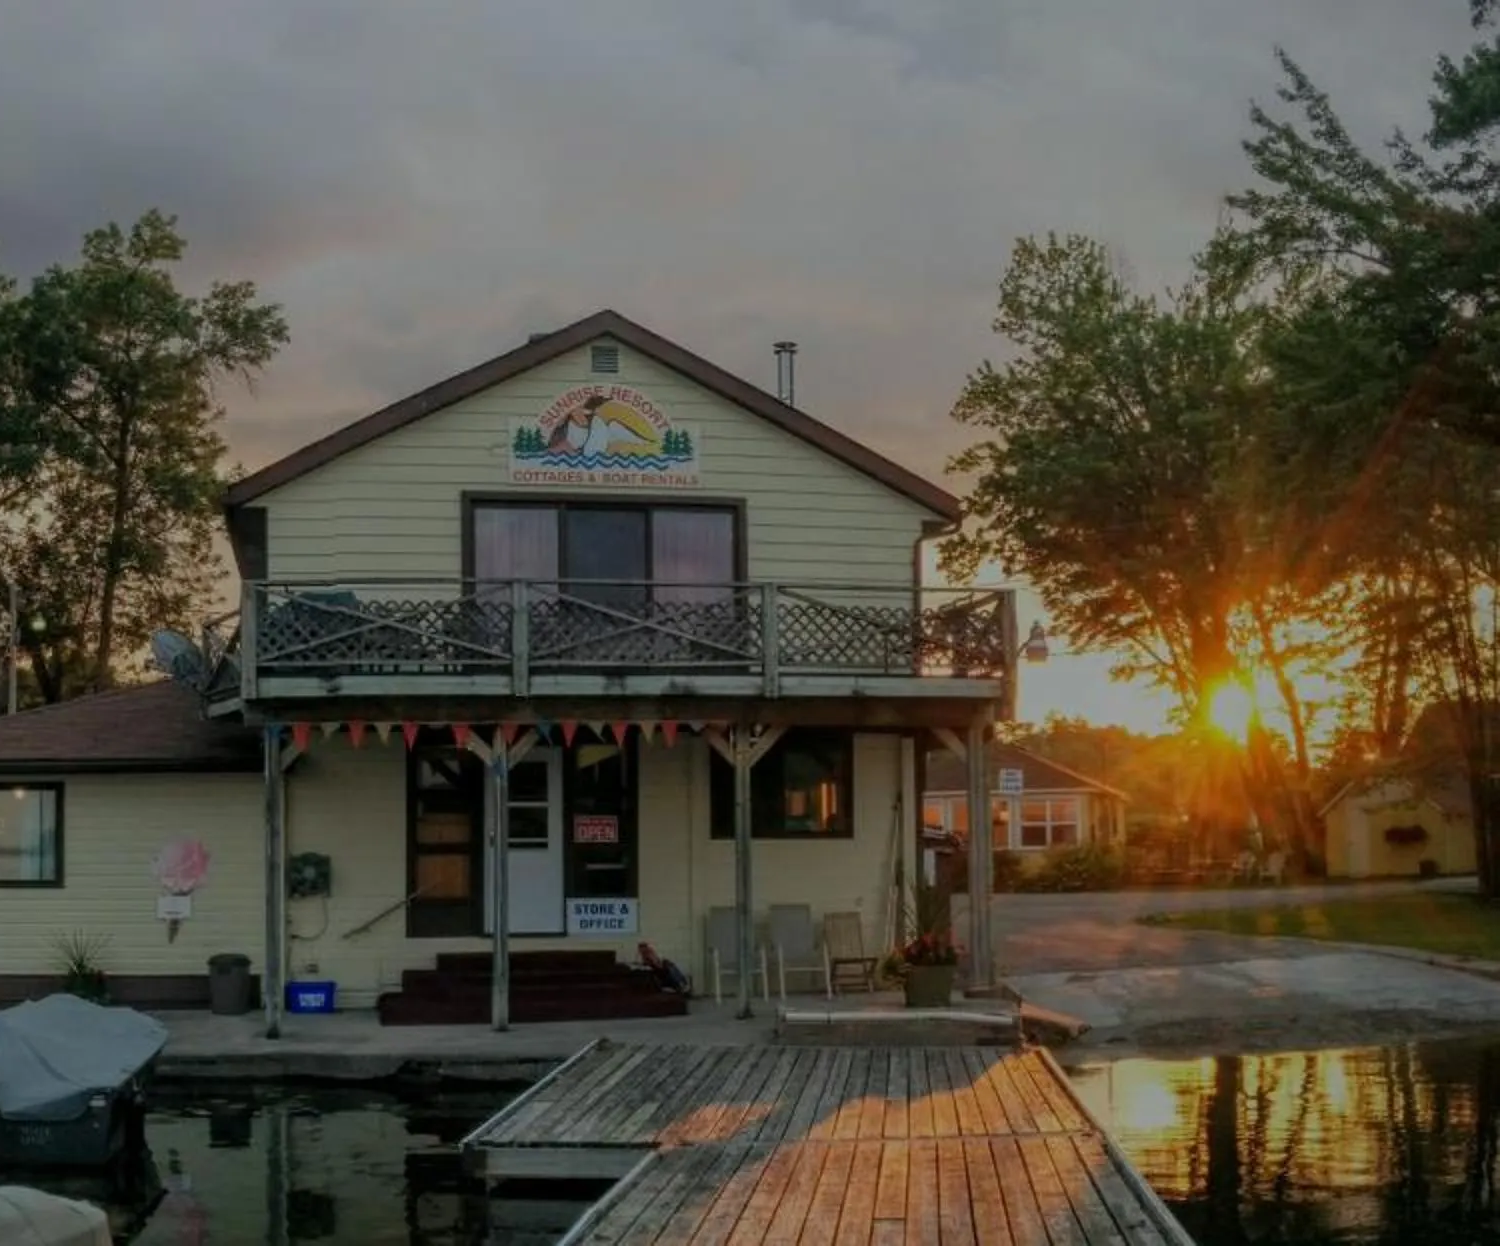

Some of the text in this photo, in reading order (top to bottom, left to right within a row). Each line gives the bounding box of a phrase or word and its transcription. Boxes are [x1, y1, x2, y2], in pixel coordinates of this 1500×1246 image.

[540, 385, 670, 430] SUNRISE RESORT
[513, 471, 698, 486] COTTAGES & BOAT RENTALS
[578, 825, 615, 838] OPEN
[574, 903, 629, 915] STORE &
[579, 919, 625, 929] OFFICE
